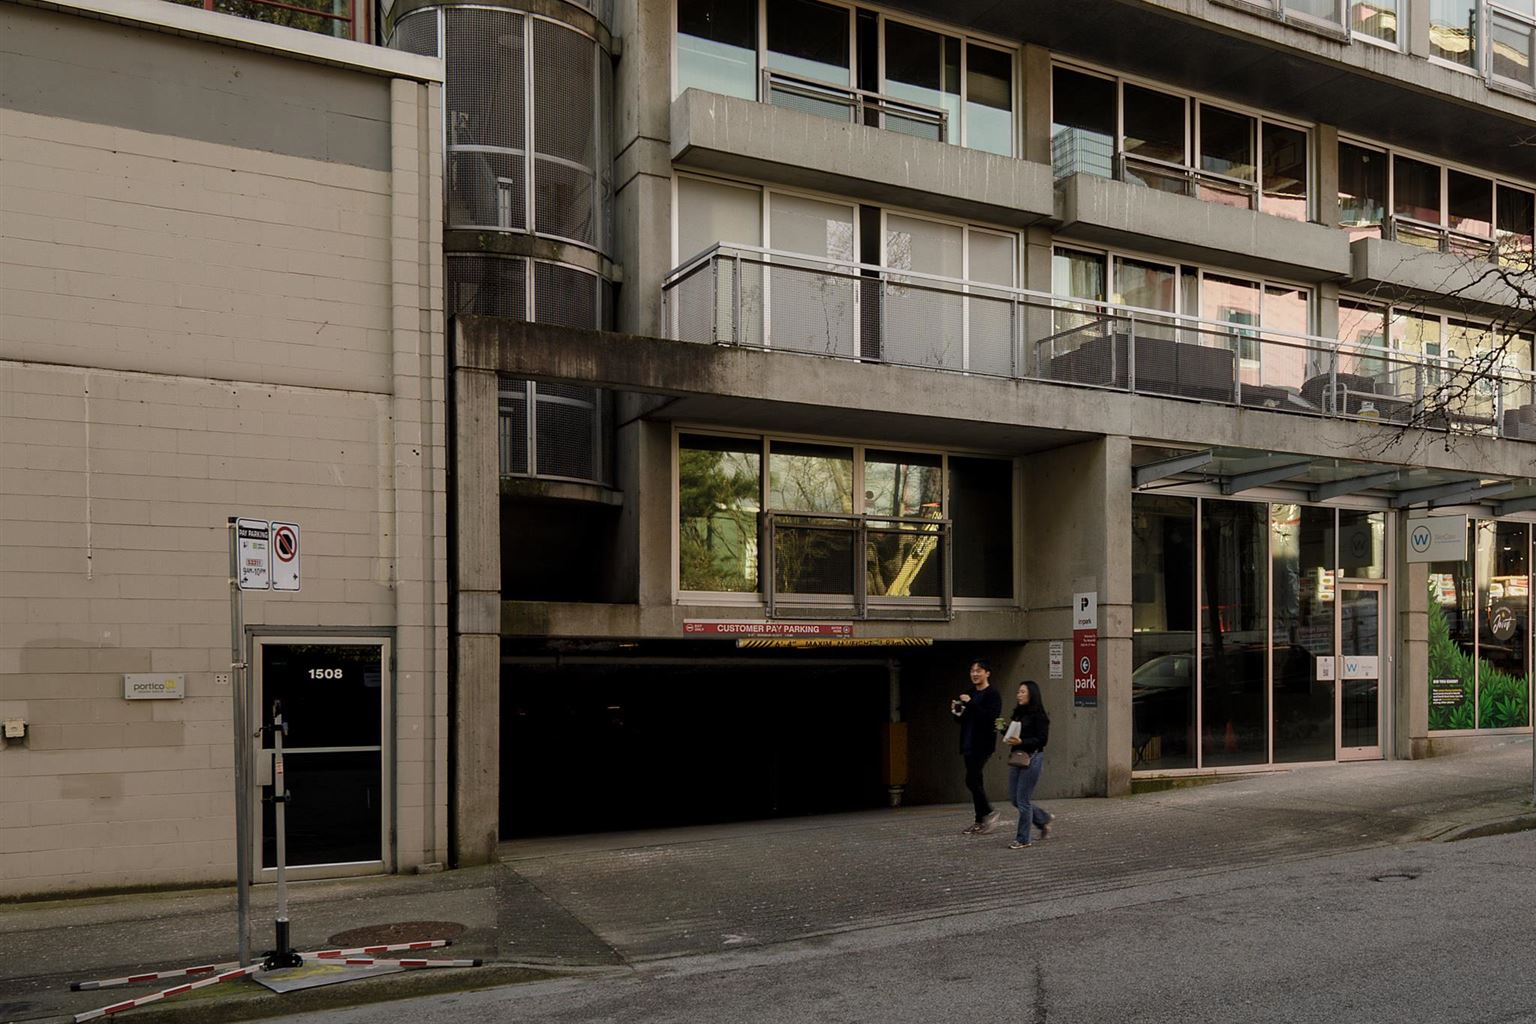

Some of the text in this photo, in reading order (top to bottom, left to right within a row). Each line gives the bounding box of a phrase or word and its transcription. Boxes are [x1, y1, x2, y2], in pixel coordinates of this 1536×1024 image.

[248, 530, 268, 538] PARKING
[1413, 534, 1429, 546] W
[717, 624, 820, 633] CUSTOMER PAY PARKING
[1346, 663, 1358, 673] W
[308, 669, 343, 679] 1508
[133, 682, 165, 692] portico
[1075, 674, 1096, 692] park
